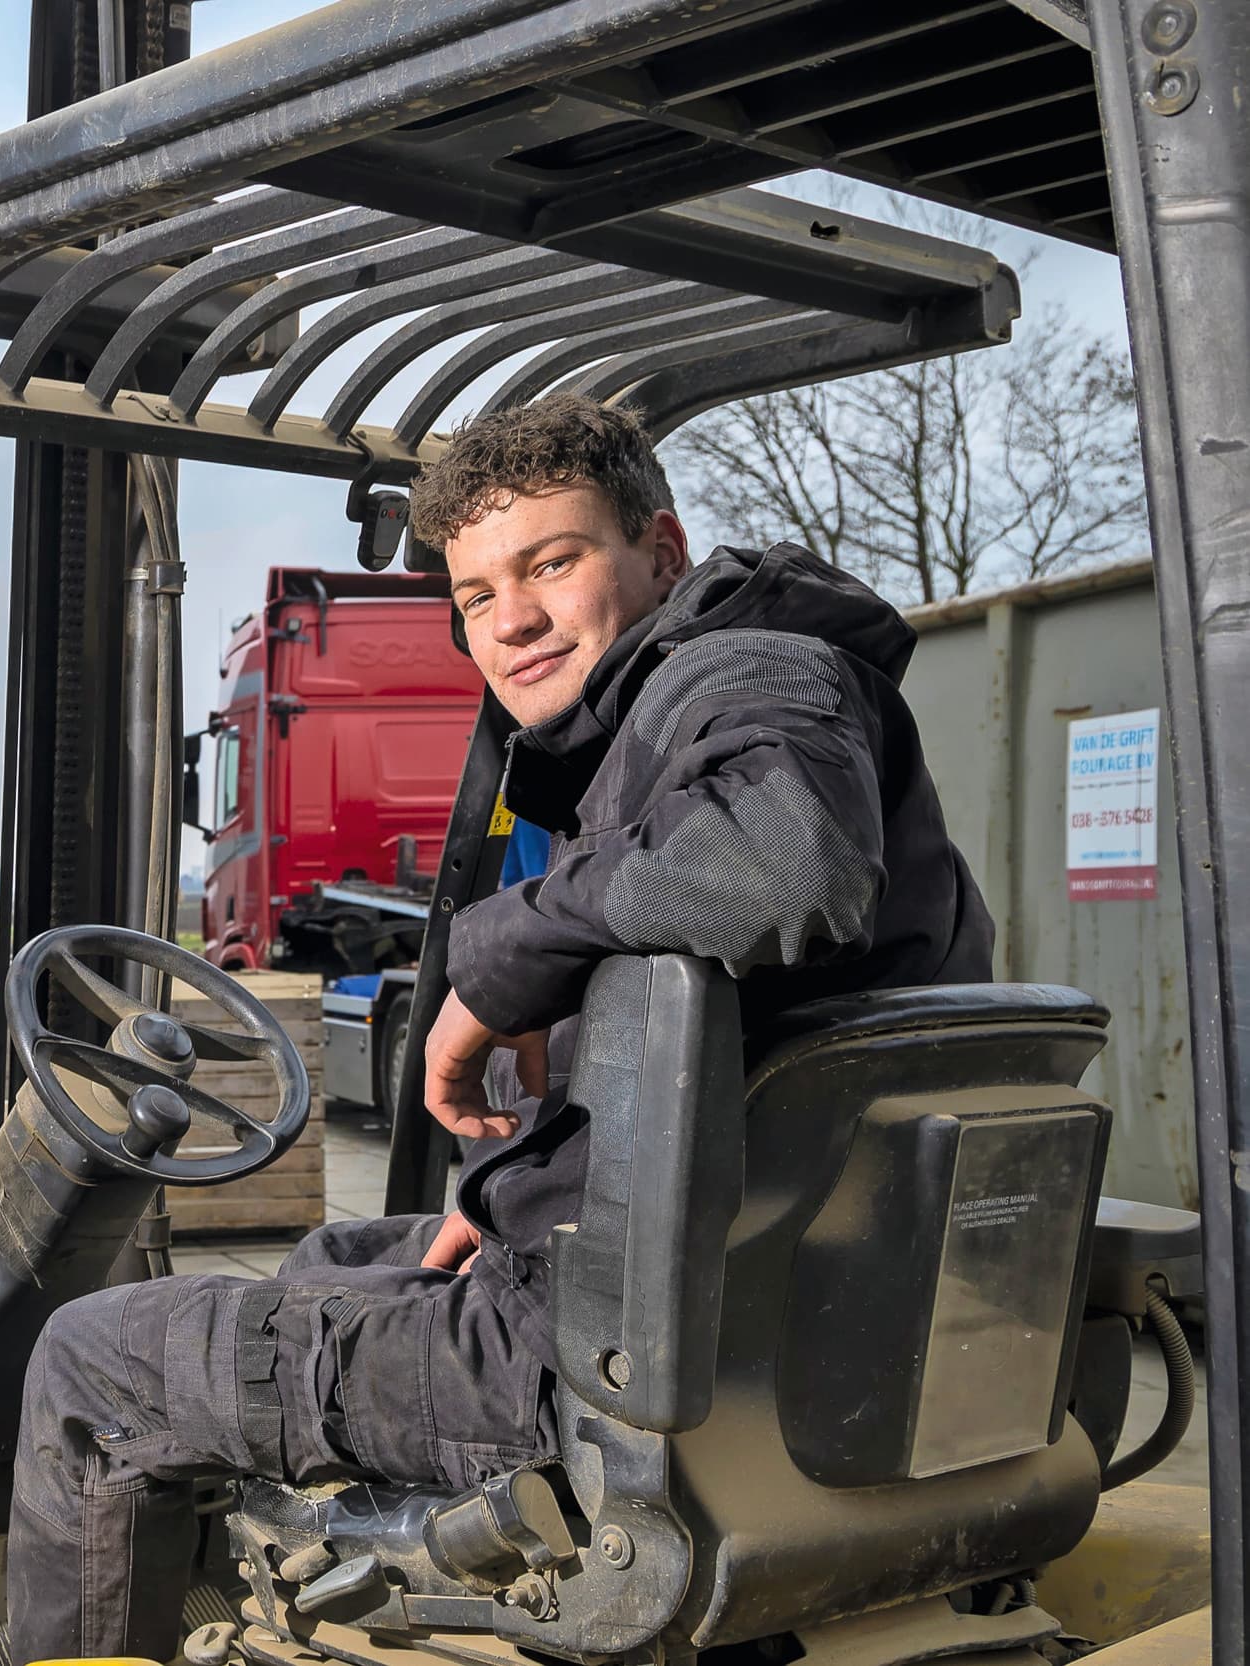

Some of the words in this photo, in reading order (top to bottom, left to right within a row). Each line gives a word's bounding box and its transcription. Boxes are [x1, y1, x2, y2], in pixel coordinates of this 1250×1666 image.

[349, 638, 472, 667] SCAN
[1074, 735, 1097, 753] VAN
[1101, 732, 1117, 749] DE
[1120, 727, 1155, 748] GRIFT
[1072, 754, 1132, 775] FOURAGE
[1072, 812, 1092, 828] 038
[953, 1201, 974, 1211] PLACE
[974, 1196, 1010, 1209] OPERATING
[1010, 1193, 1038, 1204] MANUAL
